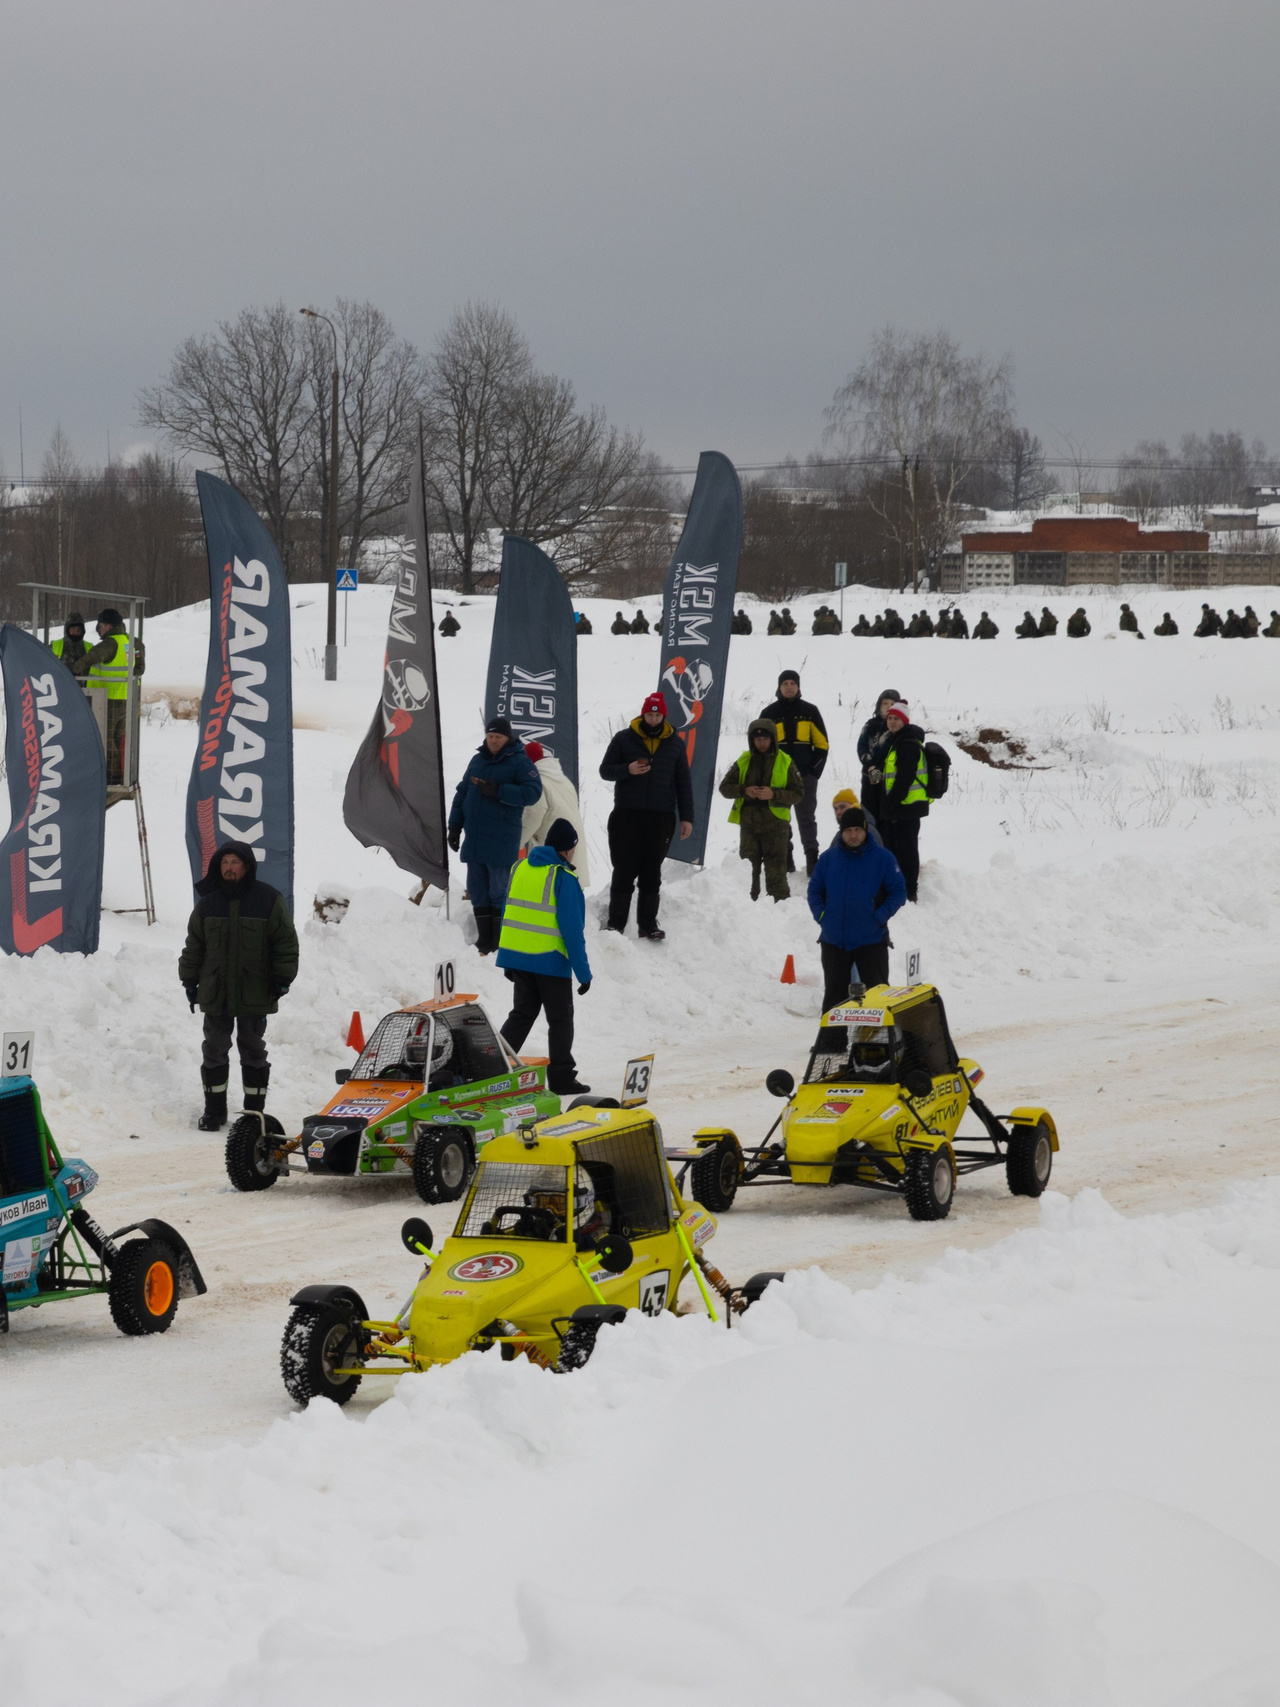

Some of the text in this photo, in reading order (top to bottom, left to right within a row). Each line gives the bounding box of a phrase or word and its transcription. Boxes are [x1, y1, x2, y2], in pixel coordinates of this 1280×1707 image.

[908, 952, 920, 977] 81
[437, 961, 455, 996] 10
[6, 1039, 31, 1071] 31
[488, 1080, 511, 1094] RUSTA
[625, 1065, 650, 1094] 43
[331, 1106, 382, 1115] LIQUI
[895, 1122, 909, 1140] 81
[21, 1197, 48, 1215] Иван
[85, 1217, 120, 1258] YAMAH
[641, 1284, 667, 1318] 43
